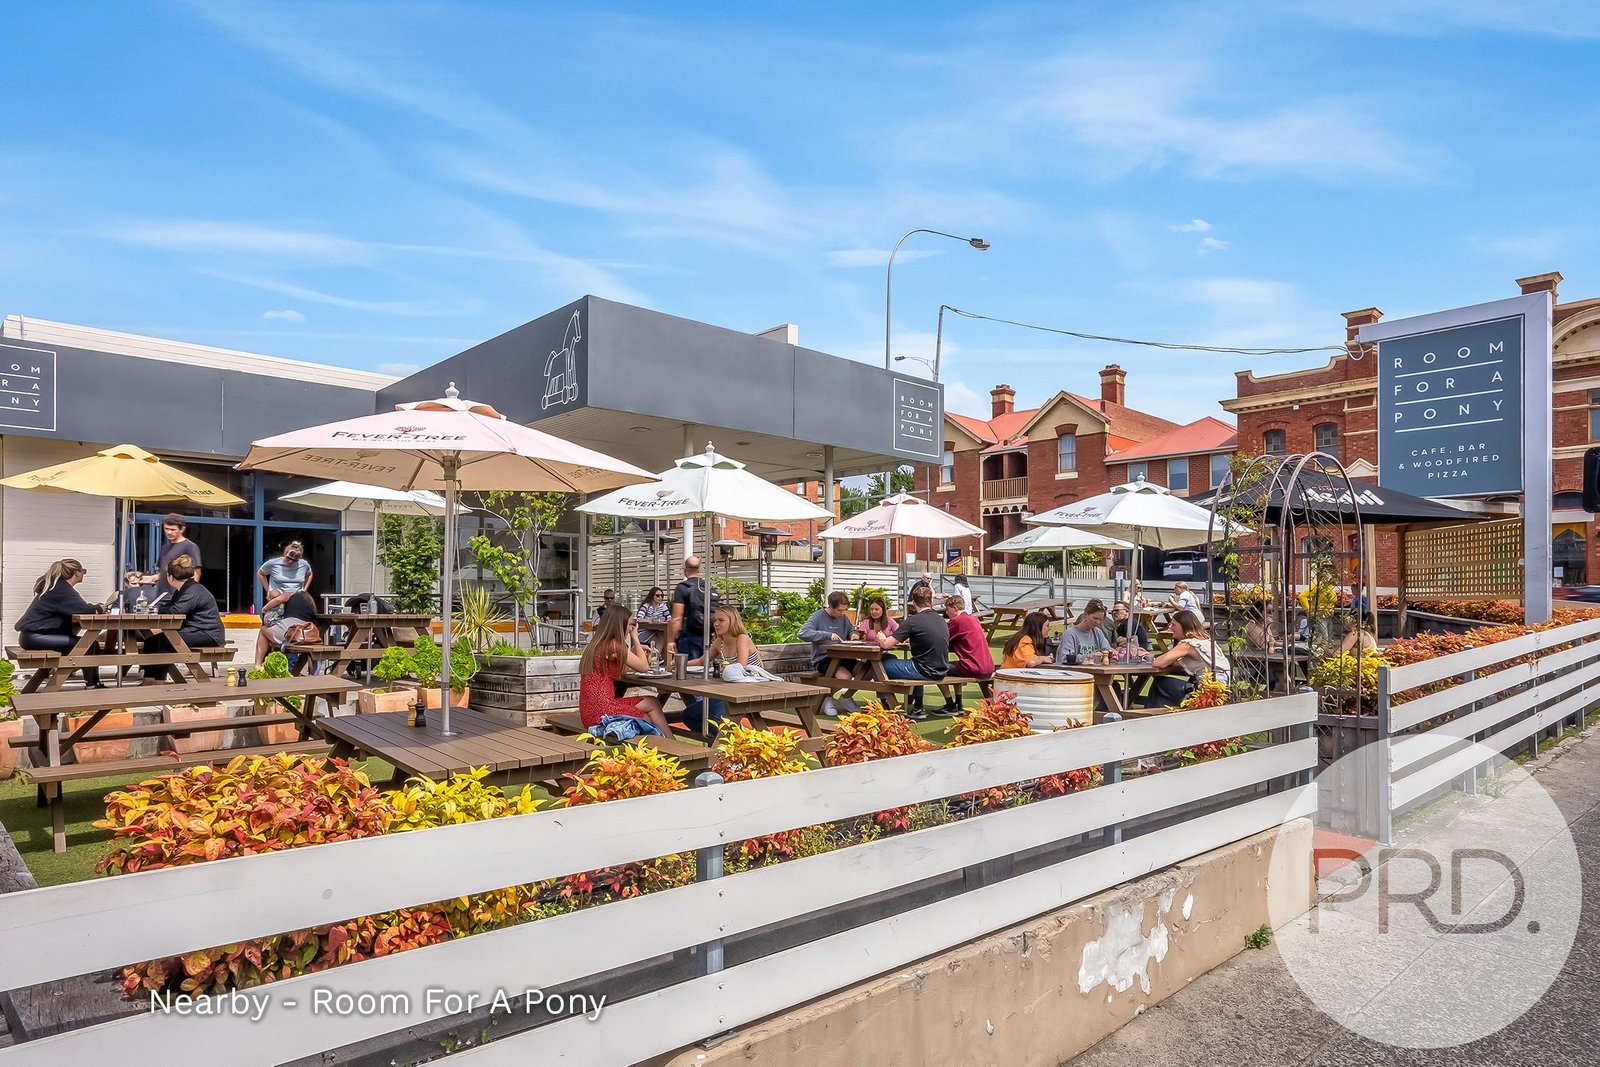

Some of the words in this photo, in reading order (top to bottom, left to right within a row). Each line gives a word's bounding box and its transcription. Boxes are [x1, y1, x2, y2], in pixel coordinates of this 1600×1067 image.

[1394, 341, 1503, 368] ROOM
[11, 363, 41, 374] OM
[1394, 378, 1455, 396] FOR
[1491, 371, 1503, 383] A
[11, 397, 40, 407] NY
[900, 395, 933, 408] ROOM
[900, 409, 920, 419] FOR
[1394, 399, 1503, 423] PONY
[900, 424, 933, 436] PONY
[331, 431, 467, 441] FEVER-TREE
[1458, 443, 1486, 452] BAR
[1412, 455, 1500, 468] WOODFIRED
[1427, 470, 1468, 479] PIZZA
[618, 497, 690, 507] FEVER-TREE
